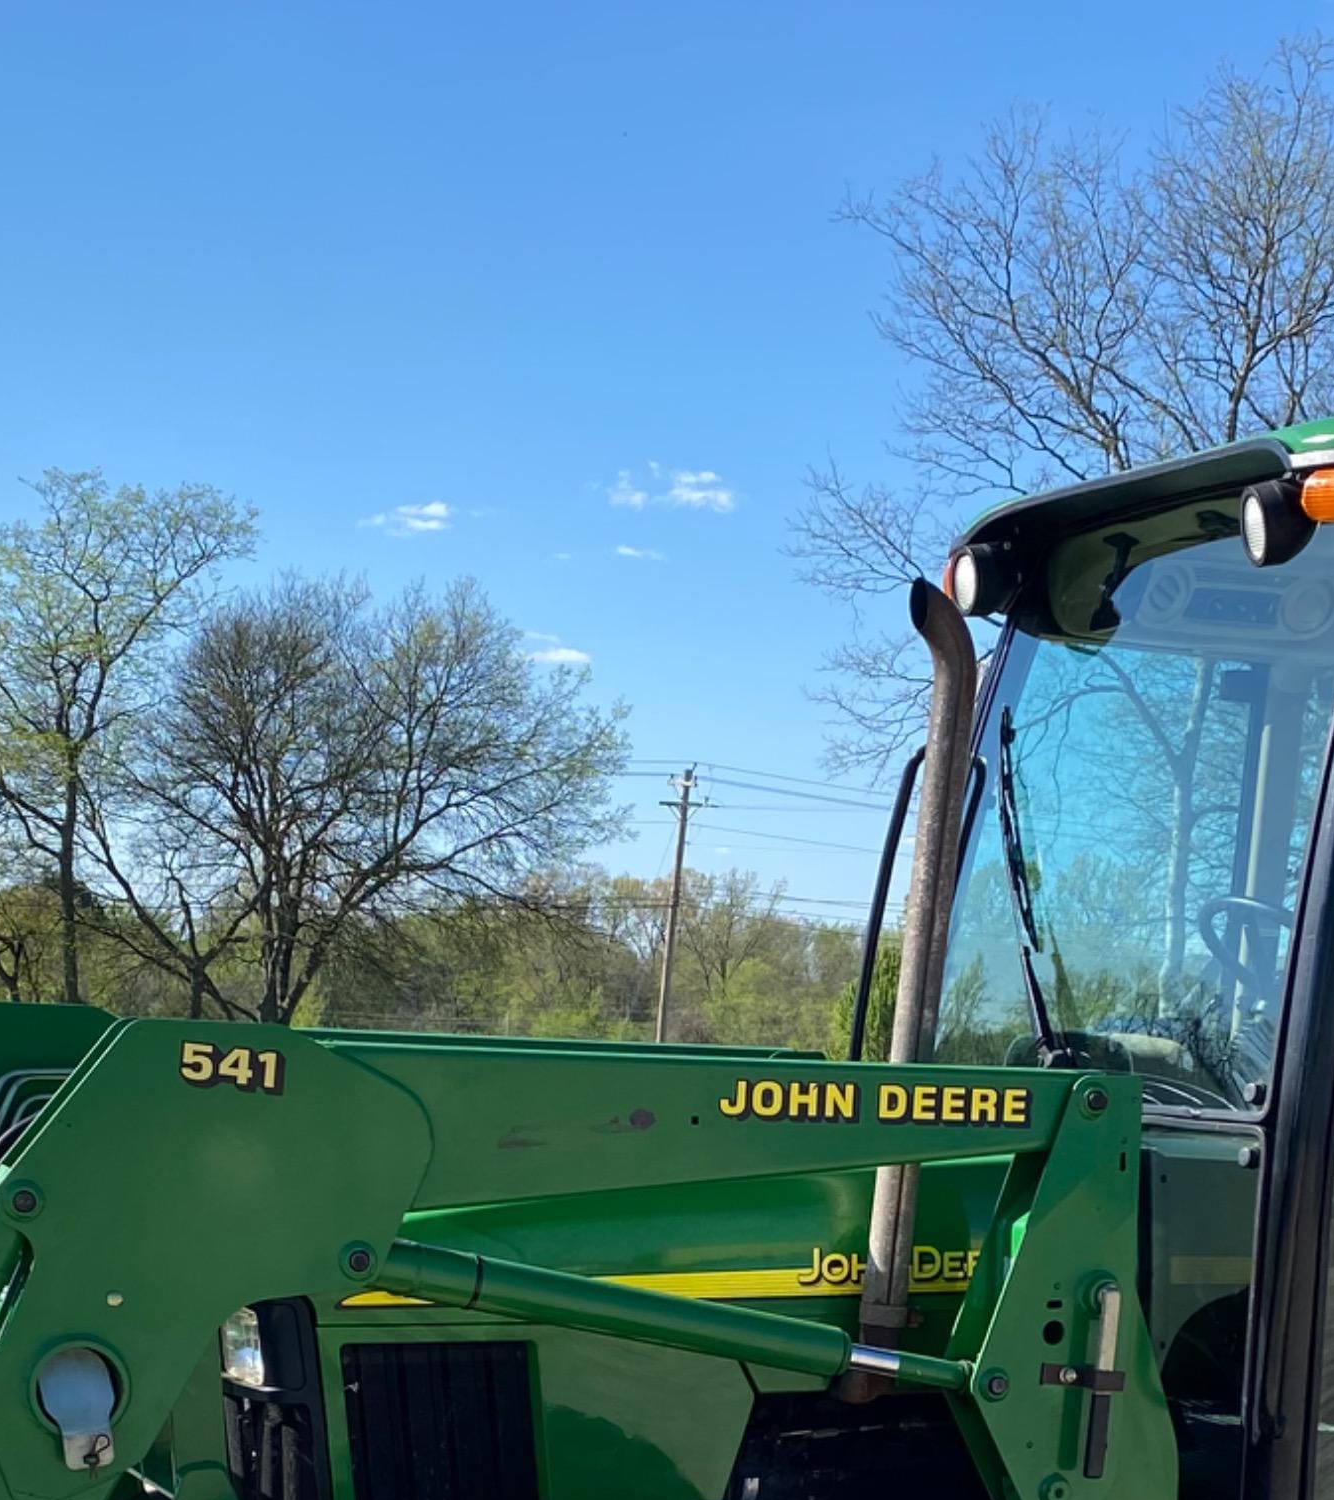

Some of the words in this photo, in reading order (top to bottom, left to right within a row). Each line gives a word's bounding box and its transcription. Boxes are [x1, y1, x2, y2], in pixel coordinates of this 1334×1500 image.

[179, 1041, 280, 1091] 541
[719, 1080, 858, 1121] JOHN
[877, 1084, 1028, 1123] DEERE
[798, 1246, 867, 1284] JOH
